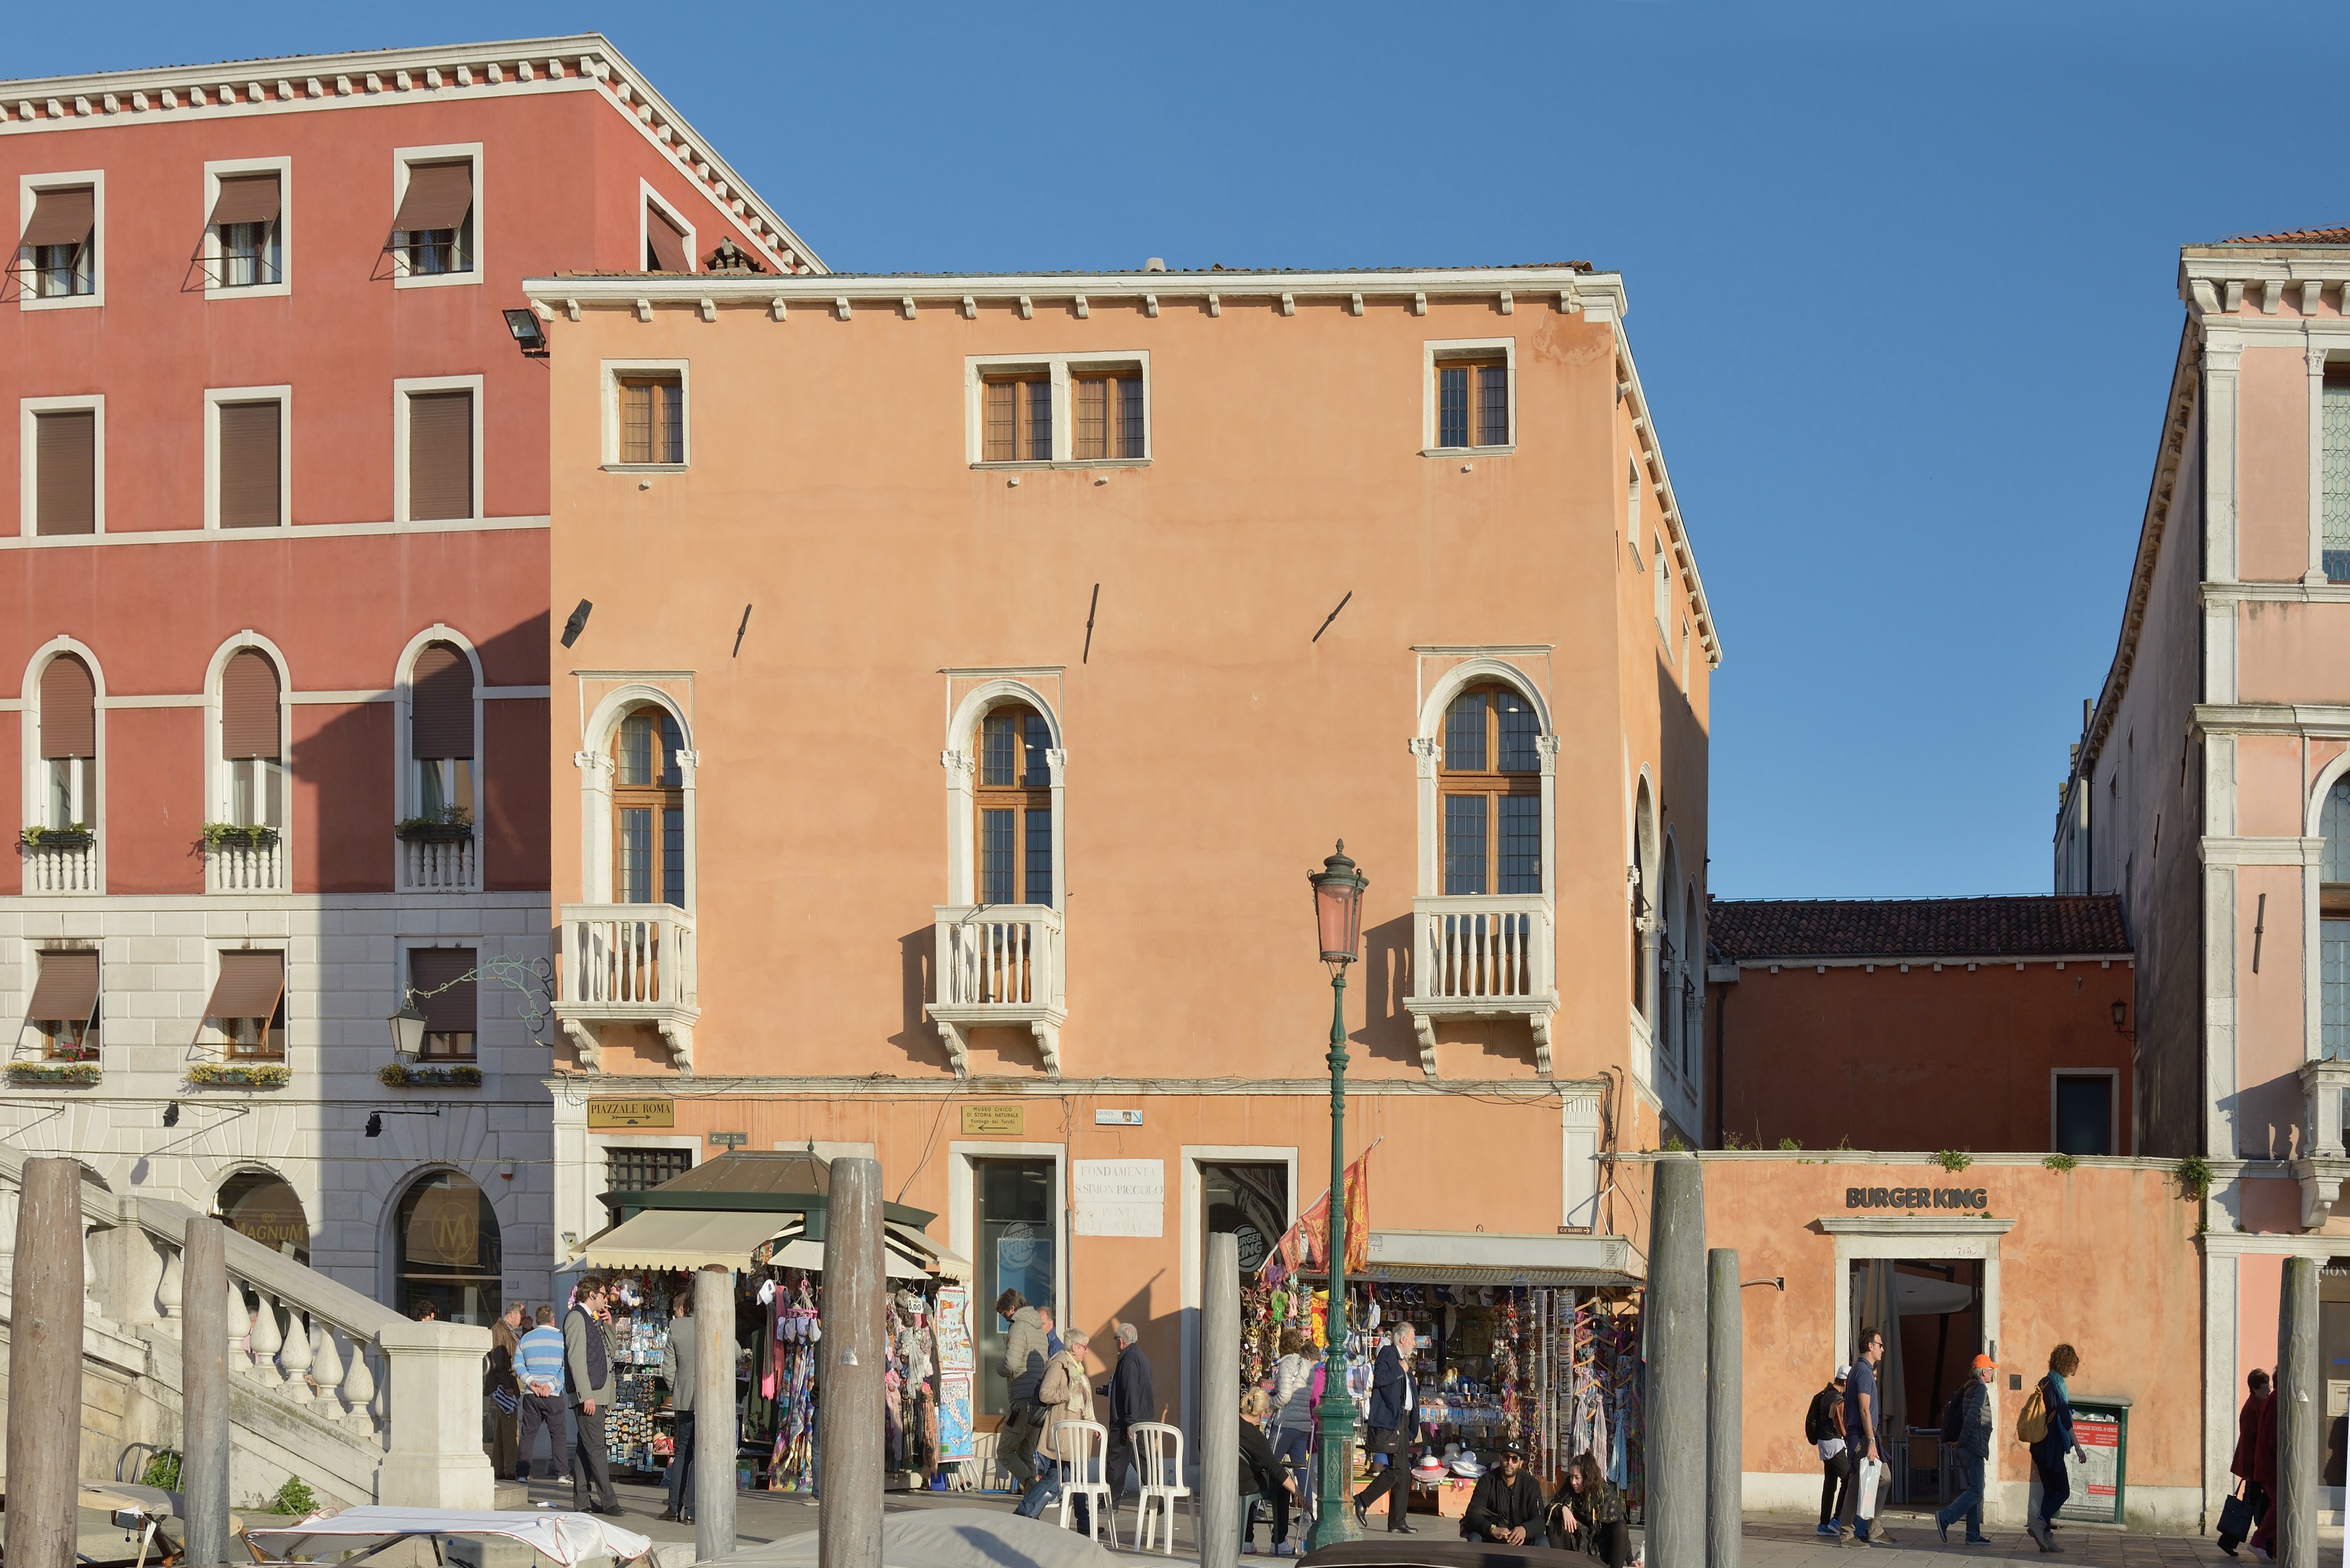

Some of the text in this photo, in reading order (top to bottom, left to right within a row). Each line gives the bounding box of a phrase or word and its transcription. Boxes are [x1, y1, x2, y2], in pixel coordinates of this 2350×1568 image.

[591, 1104, 670, 1114] PIAZZALE ROMA
[1081, 1166, 1156, 1177] FONDAMENTA
[1117, 1184, 1163, 1195] PICCOLO
[1846, 1187, 1988, 1209] BURGER KING
[1102, 1207, 1139, 1218] PONTE
[235, 1223, 304, 1241] MAGNUM
[1005, 1236, 1035, 1257] KING
[909, 1300, 921, 1311] 8,00
